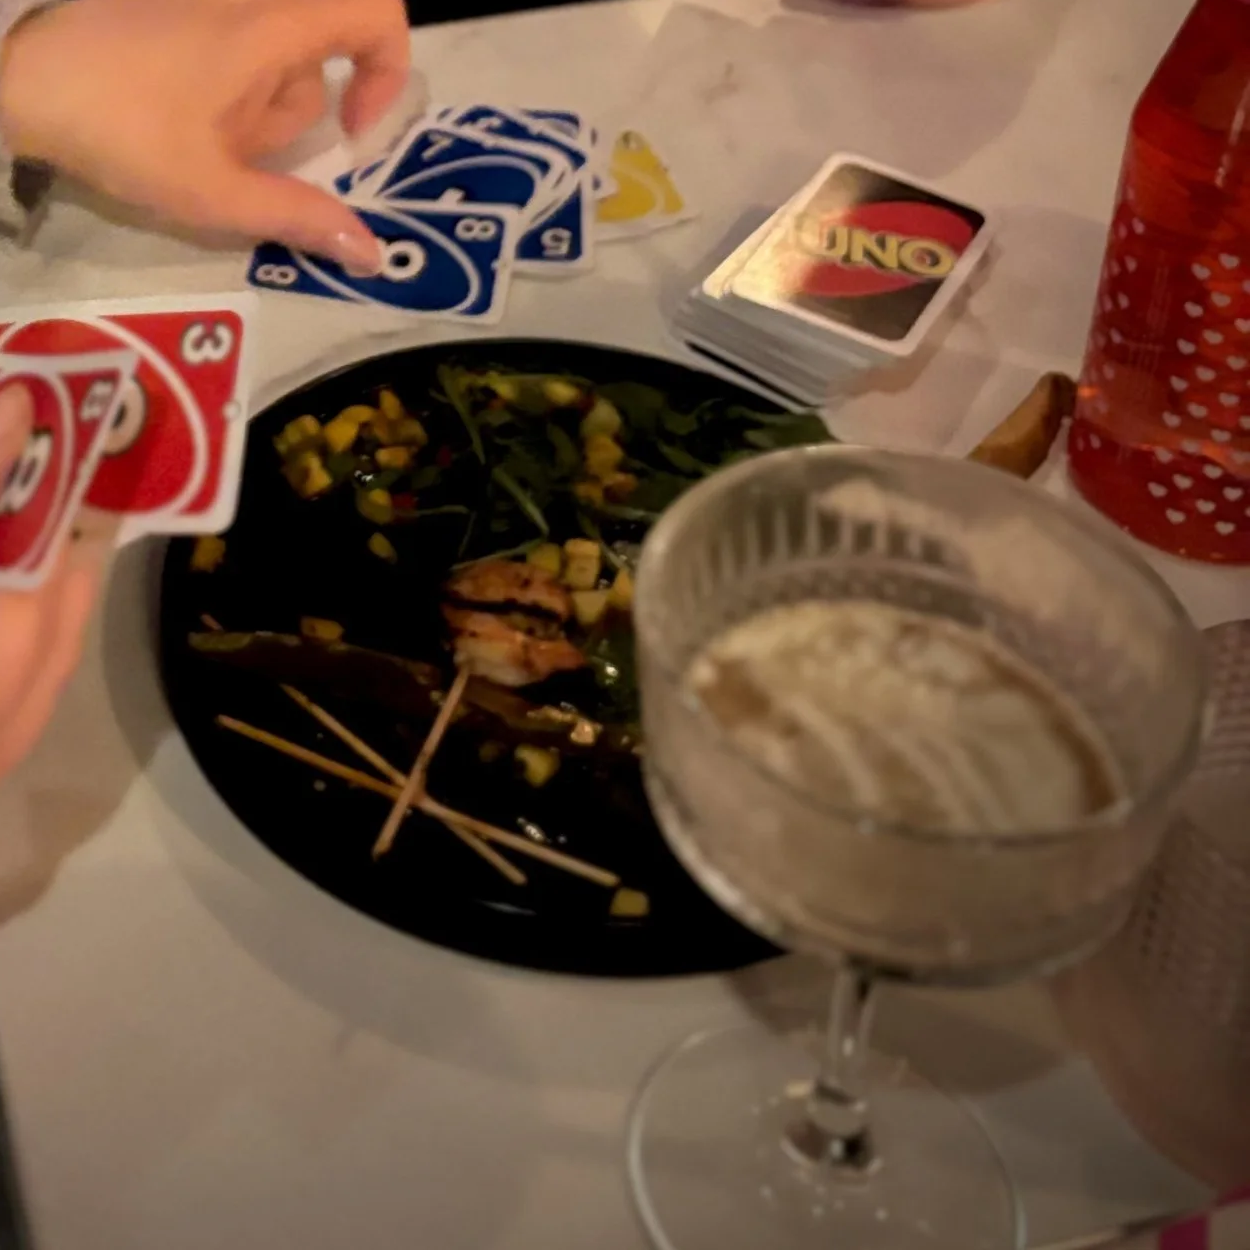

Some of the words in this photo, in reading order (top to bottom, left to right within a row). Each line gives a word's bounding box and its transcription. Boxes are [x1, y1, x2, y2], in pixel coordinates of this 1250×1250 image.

[454, 217, 497, 242] 8
[795, 211, 955, 279] UNO
[254, 263, 299, 286] 8
[180, 321, 235, 367] 3
